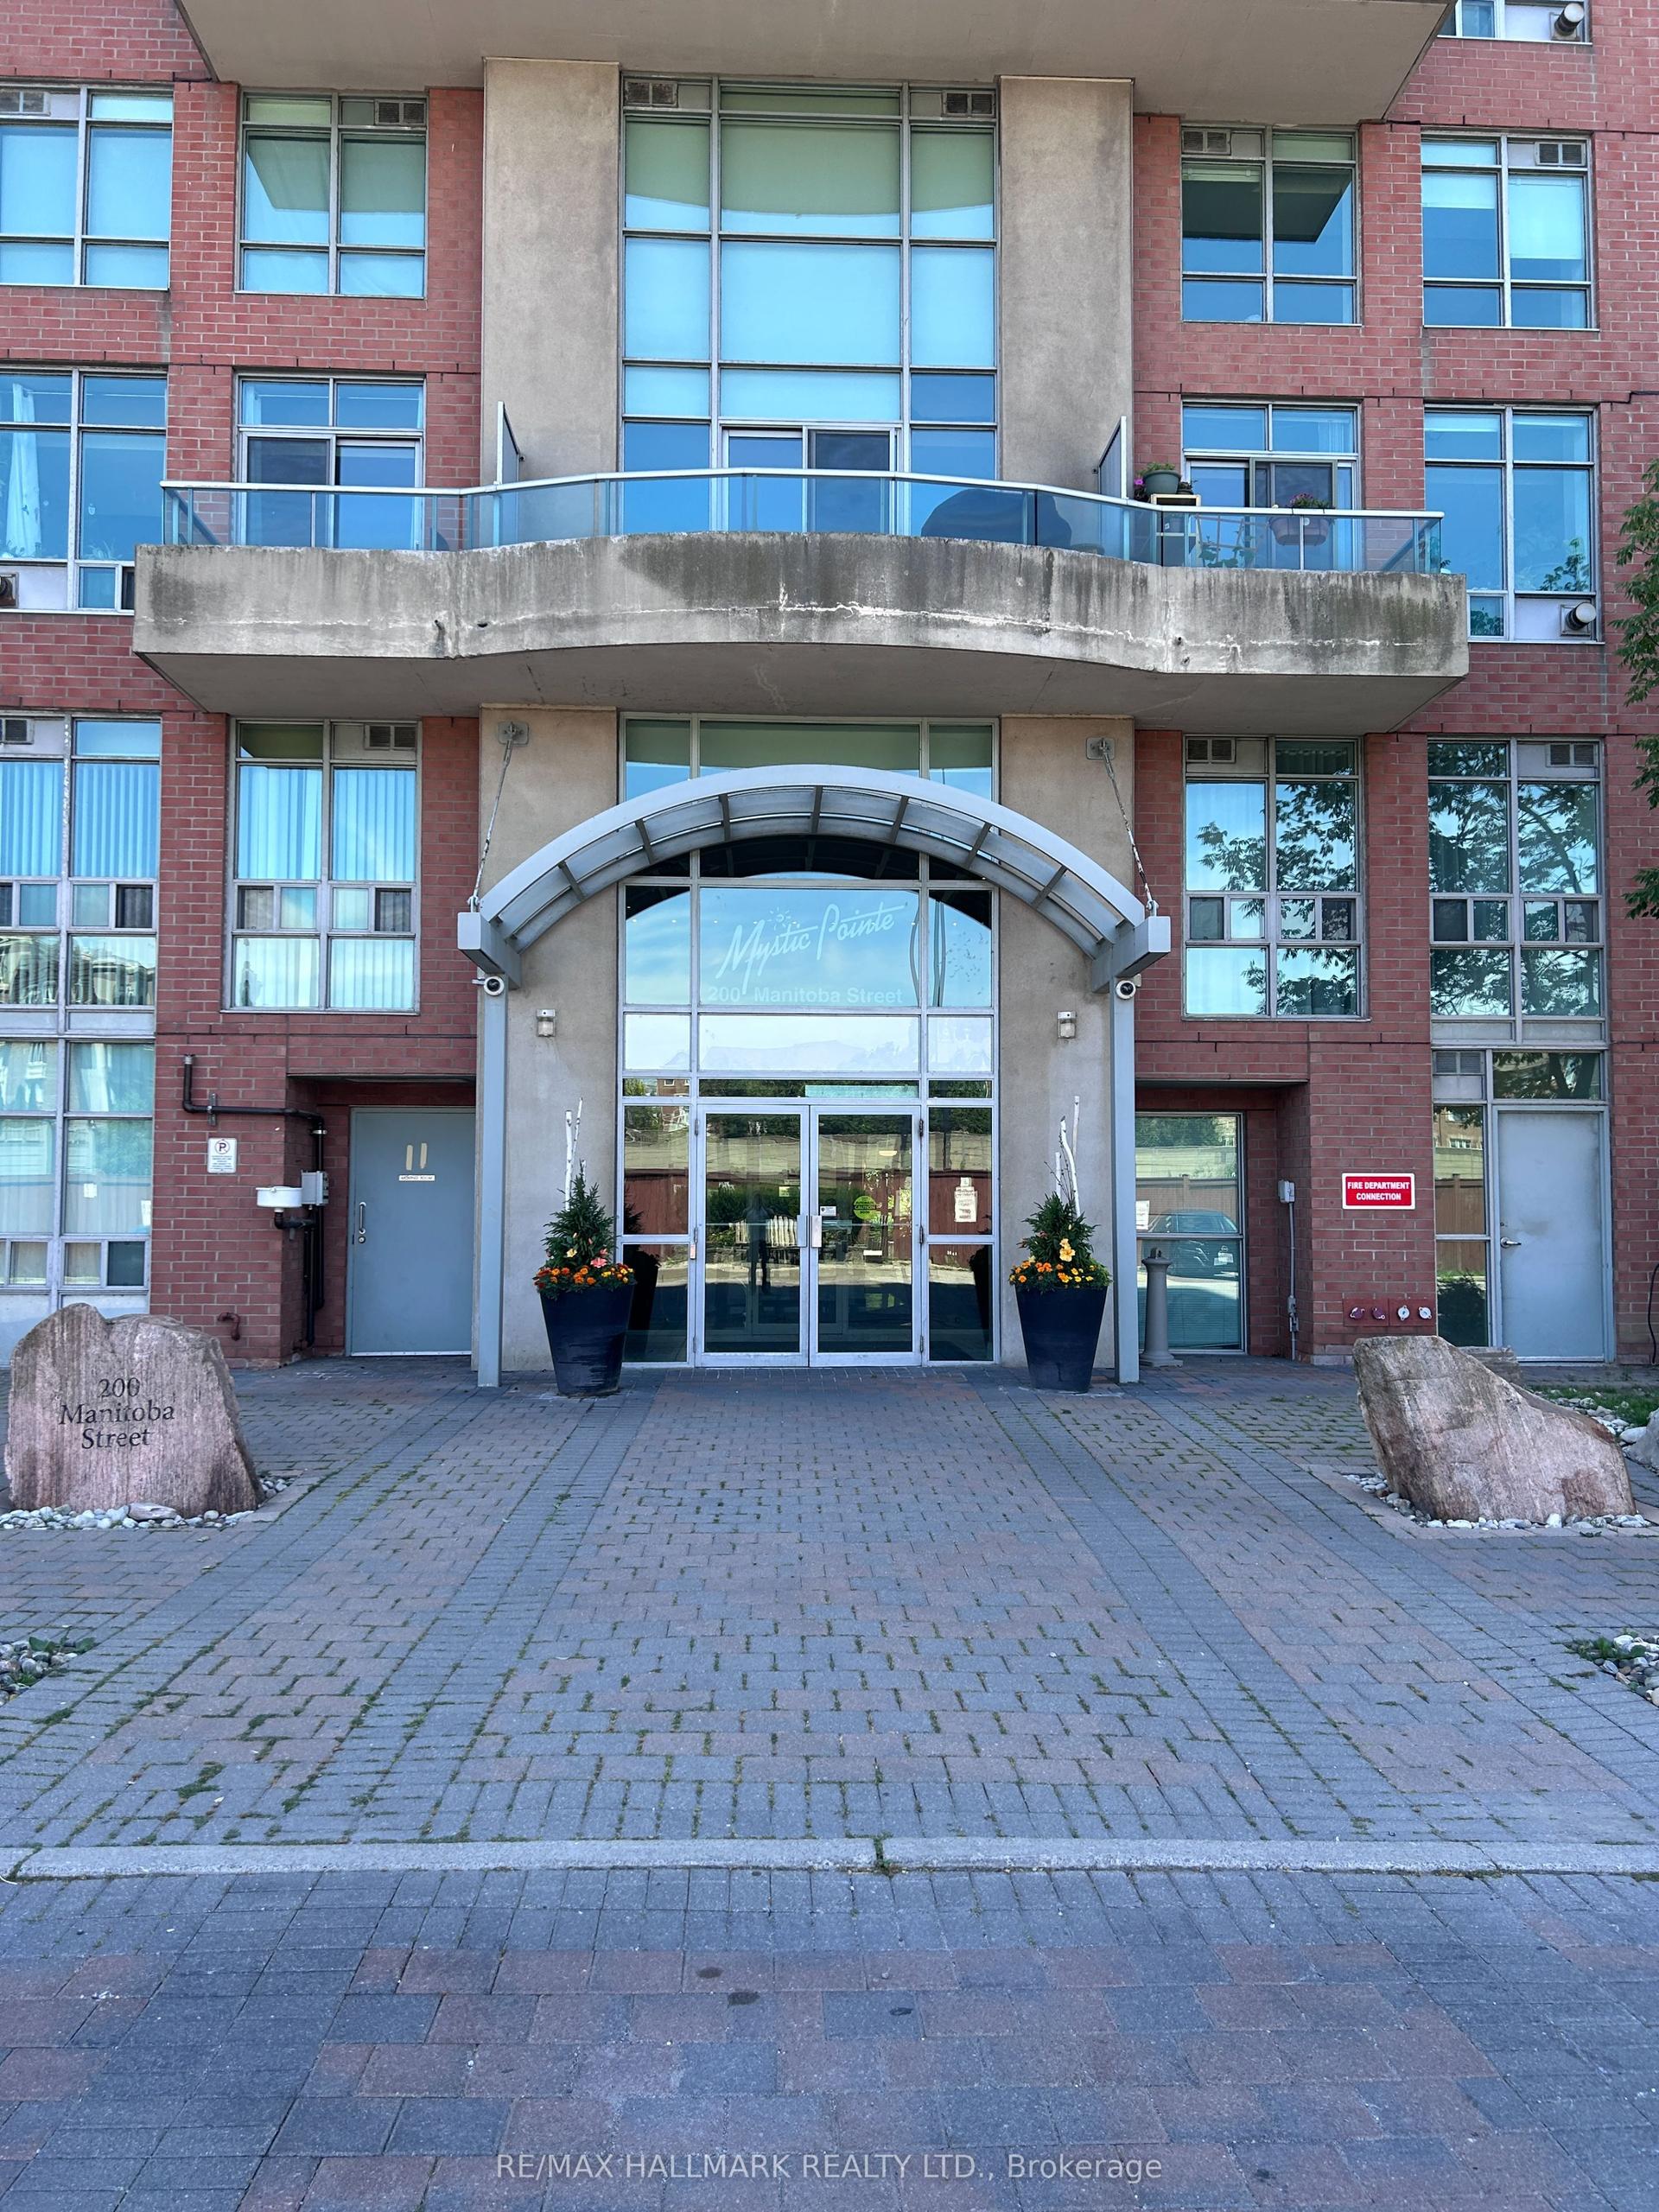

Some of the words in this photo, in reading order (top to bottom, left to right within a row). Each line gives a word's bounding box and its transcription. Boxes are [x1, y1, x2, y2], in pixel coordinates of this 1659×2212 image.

[715, 919, 819, 995] Mystic
[817, 902, 906, 960] Pointe
[708, 987, 741, 1002] 200
[754, 986, 841, 1002] Manitoba
[848, 987, 903, 1003] Street
[98, 1377, 140, 1397] 200
[59, 1400, 175, 1425] Manitoba
[81, 1428, 150, 1449] Street
